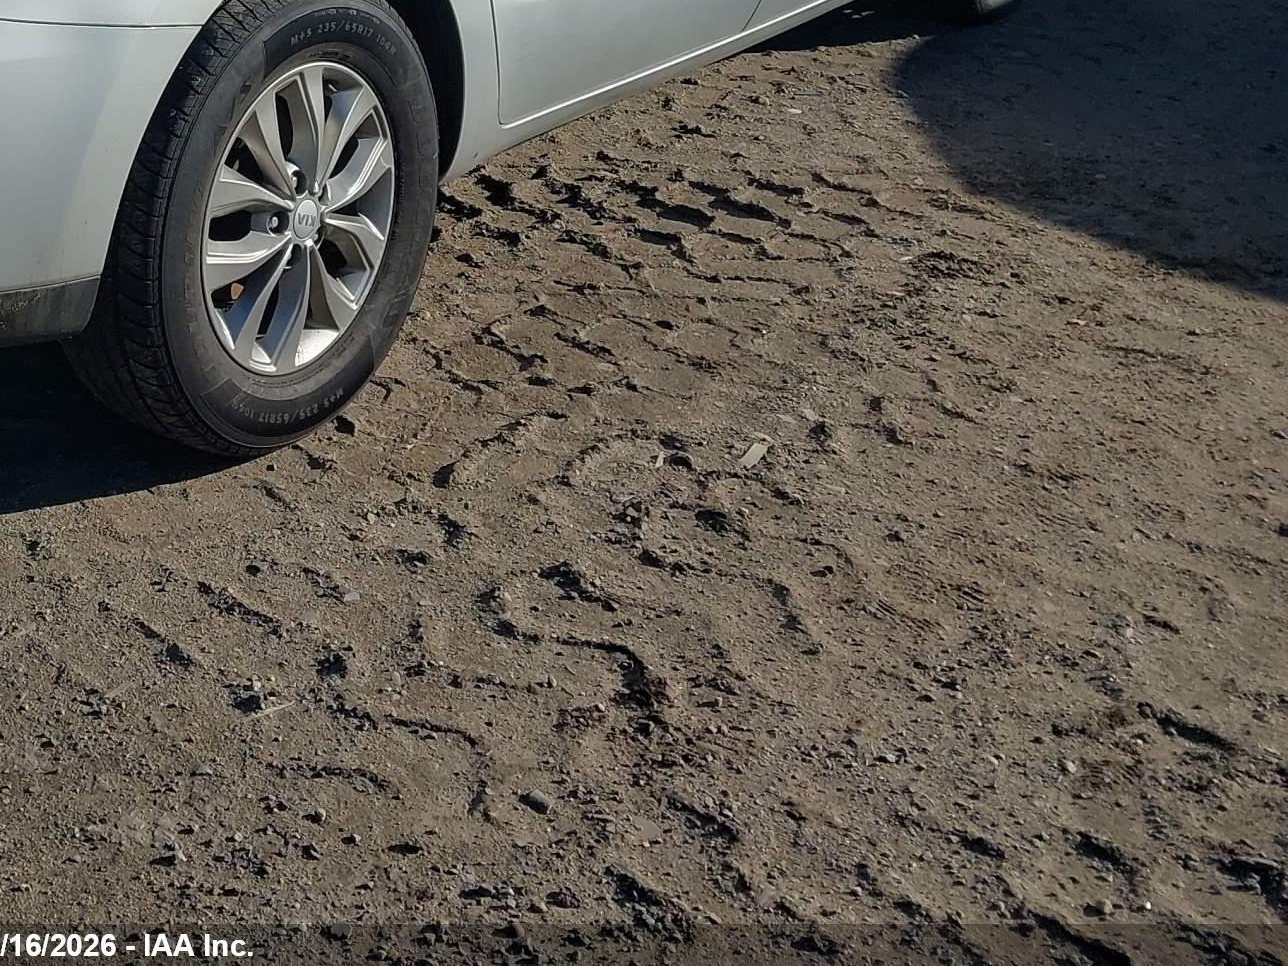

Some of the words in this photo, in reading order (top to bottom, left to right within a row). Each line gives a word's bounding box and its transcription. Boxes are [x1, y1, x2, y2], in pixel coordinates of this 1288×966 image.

[317, 20, 374, 39] 235/65R17
[297, 213, 317, 227] KIA
[258, 403, 319, 425] 235/65R17
